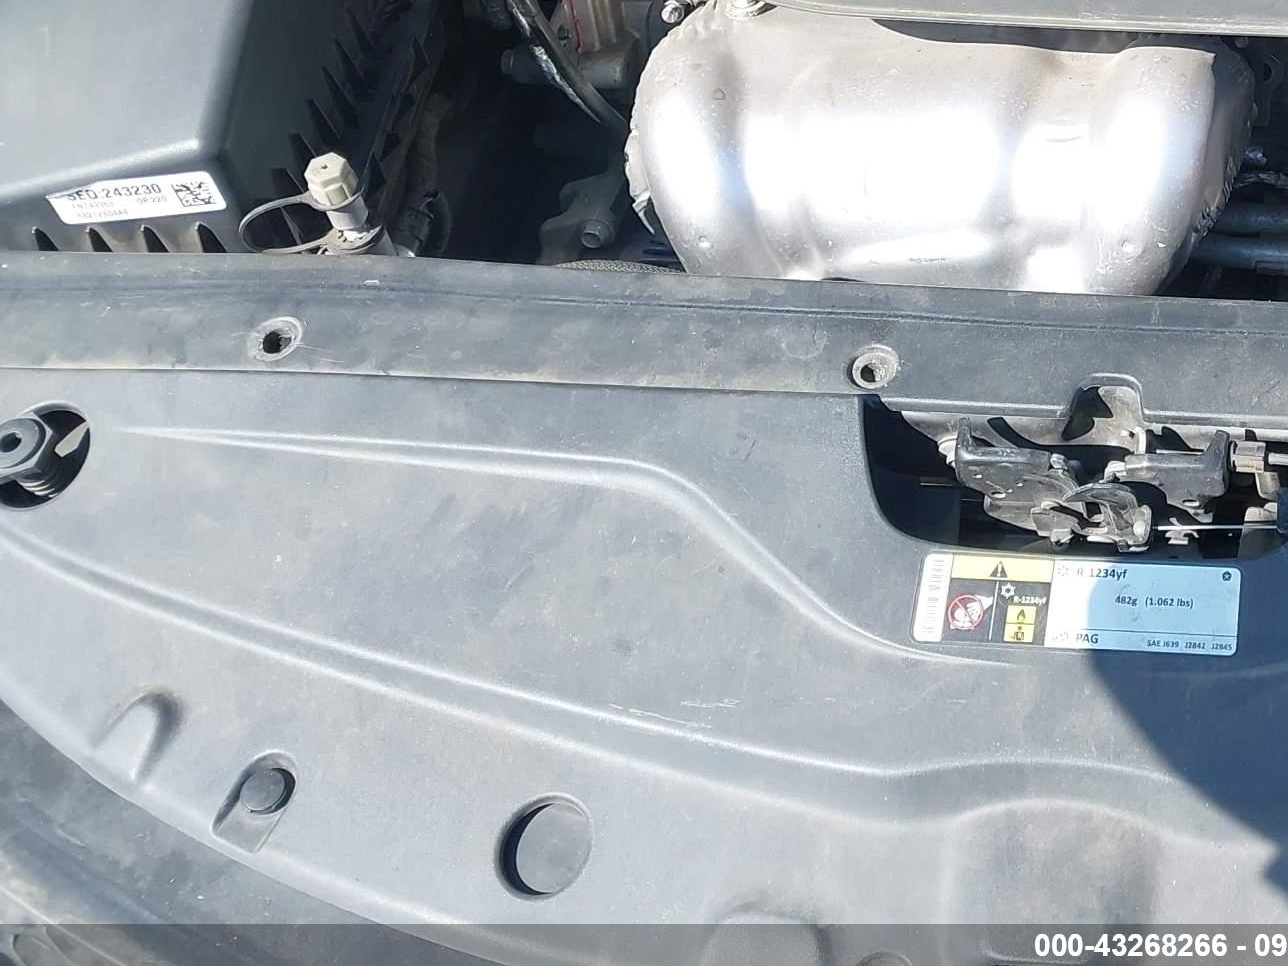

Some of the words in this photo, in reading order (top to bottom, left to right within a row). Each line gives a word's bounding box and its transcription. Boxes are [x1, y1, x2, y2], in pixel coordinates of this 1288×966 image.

[101, 183, 162, 198] 243230
[1114, 595, 1138, 607] 482g
[1144, 596, 1175, 608] (1.062
[1176, 597, 1194, 610] lbs)
[1075, 632, 1100, 645] PAG
[1146, 639, 1161, 648] SAE
[1162, 640, 1180, 649] J639
[1184, 641, 1206, 650] J2842
[1211, 642, 1233, 652] J2845
